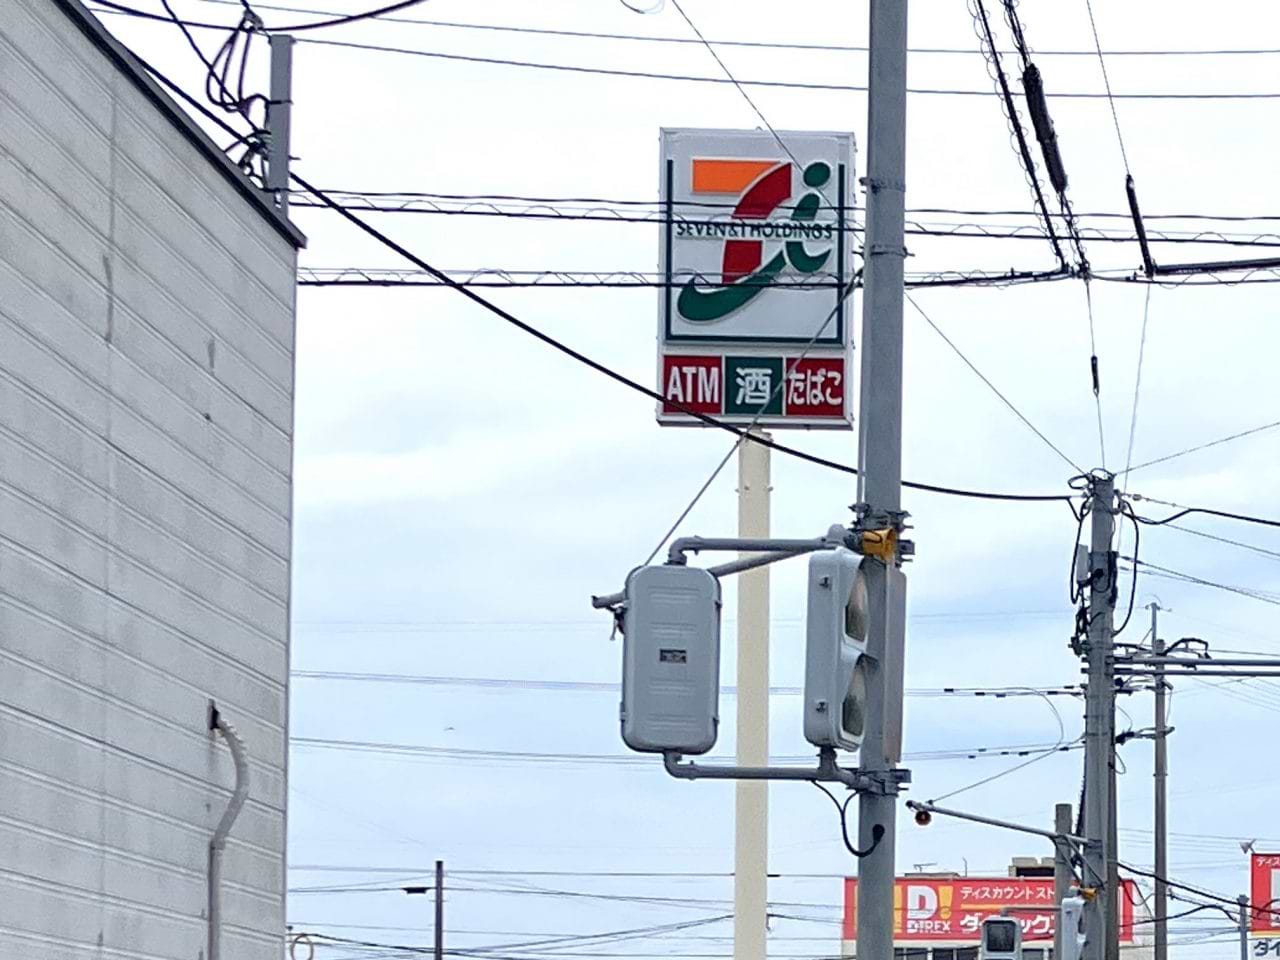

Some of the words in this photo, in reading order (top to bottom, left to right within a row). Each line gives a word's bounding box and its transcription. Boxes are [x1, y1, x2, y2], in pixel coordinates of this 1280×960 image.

[667, 366, 719, 403] ATM
[736, 367, 772, 404] 酒
[788, 369, 842, 405] たばこ
